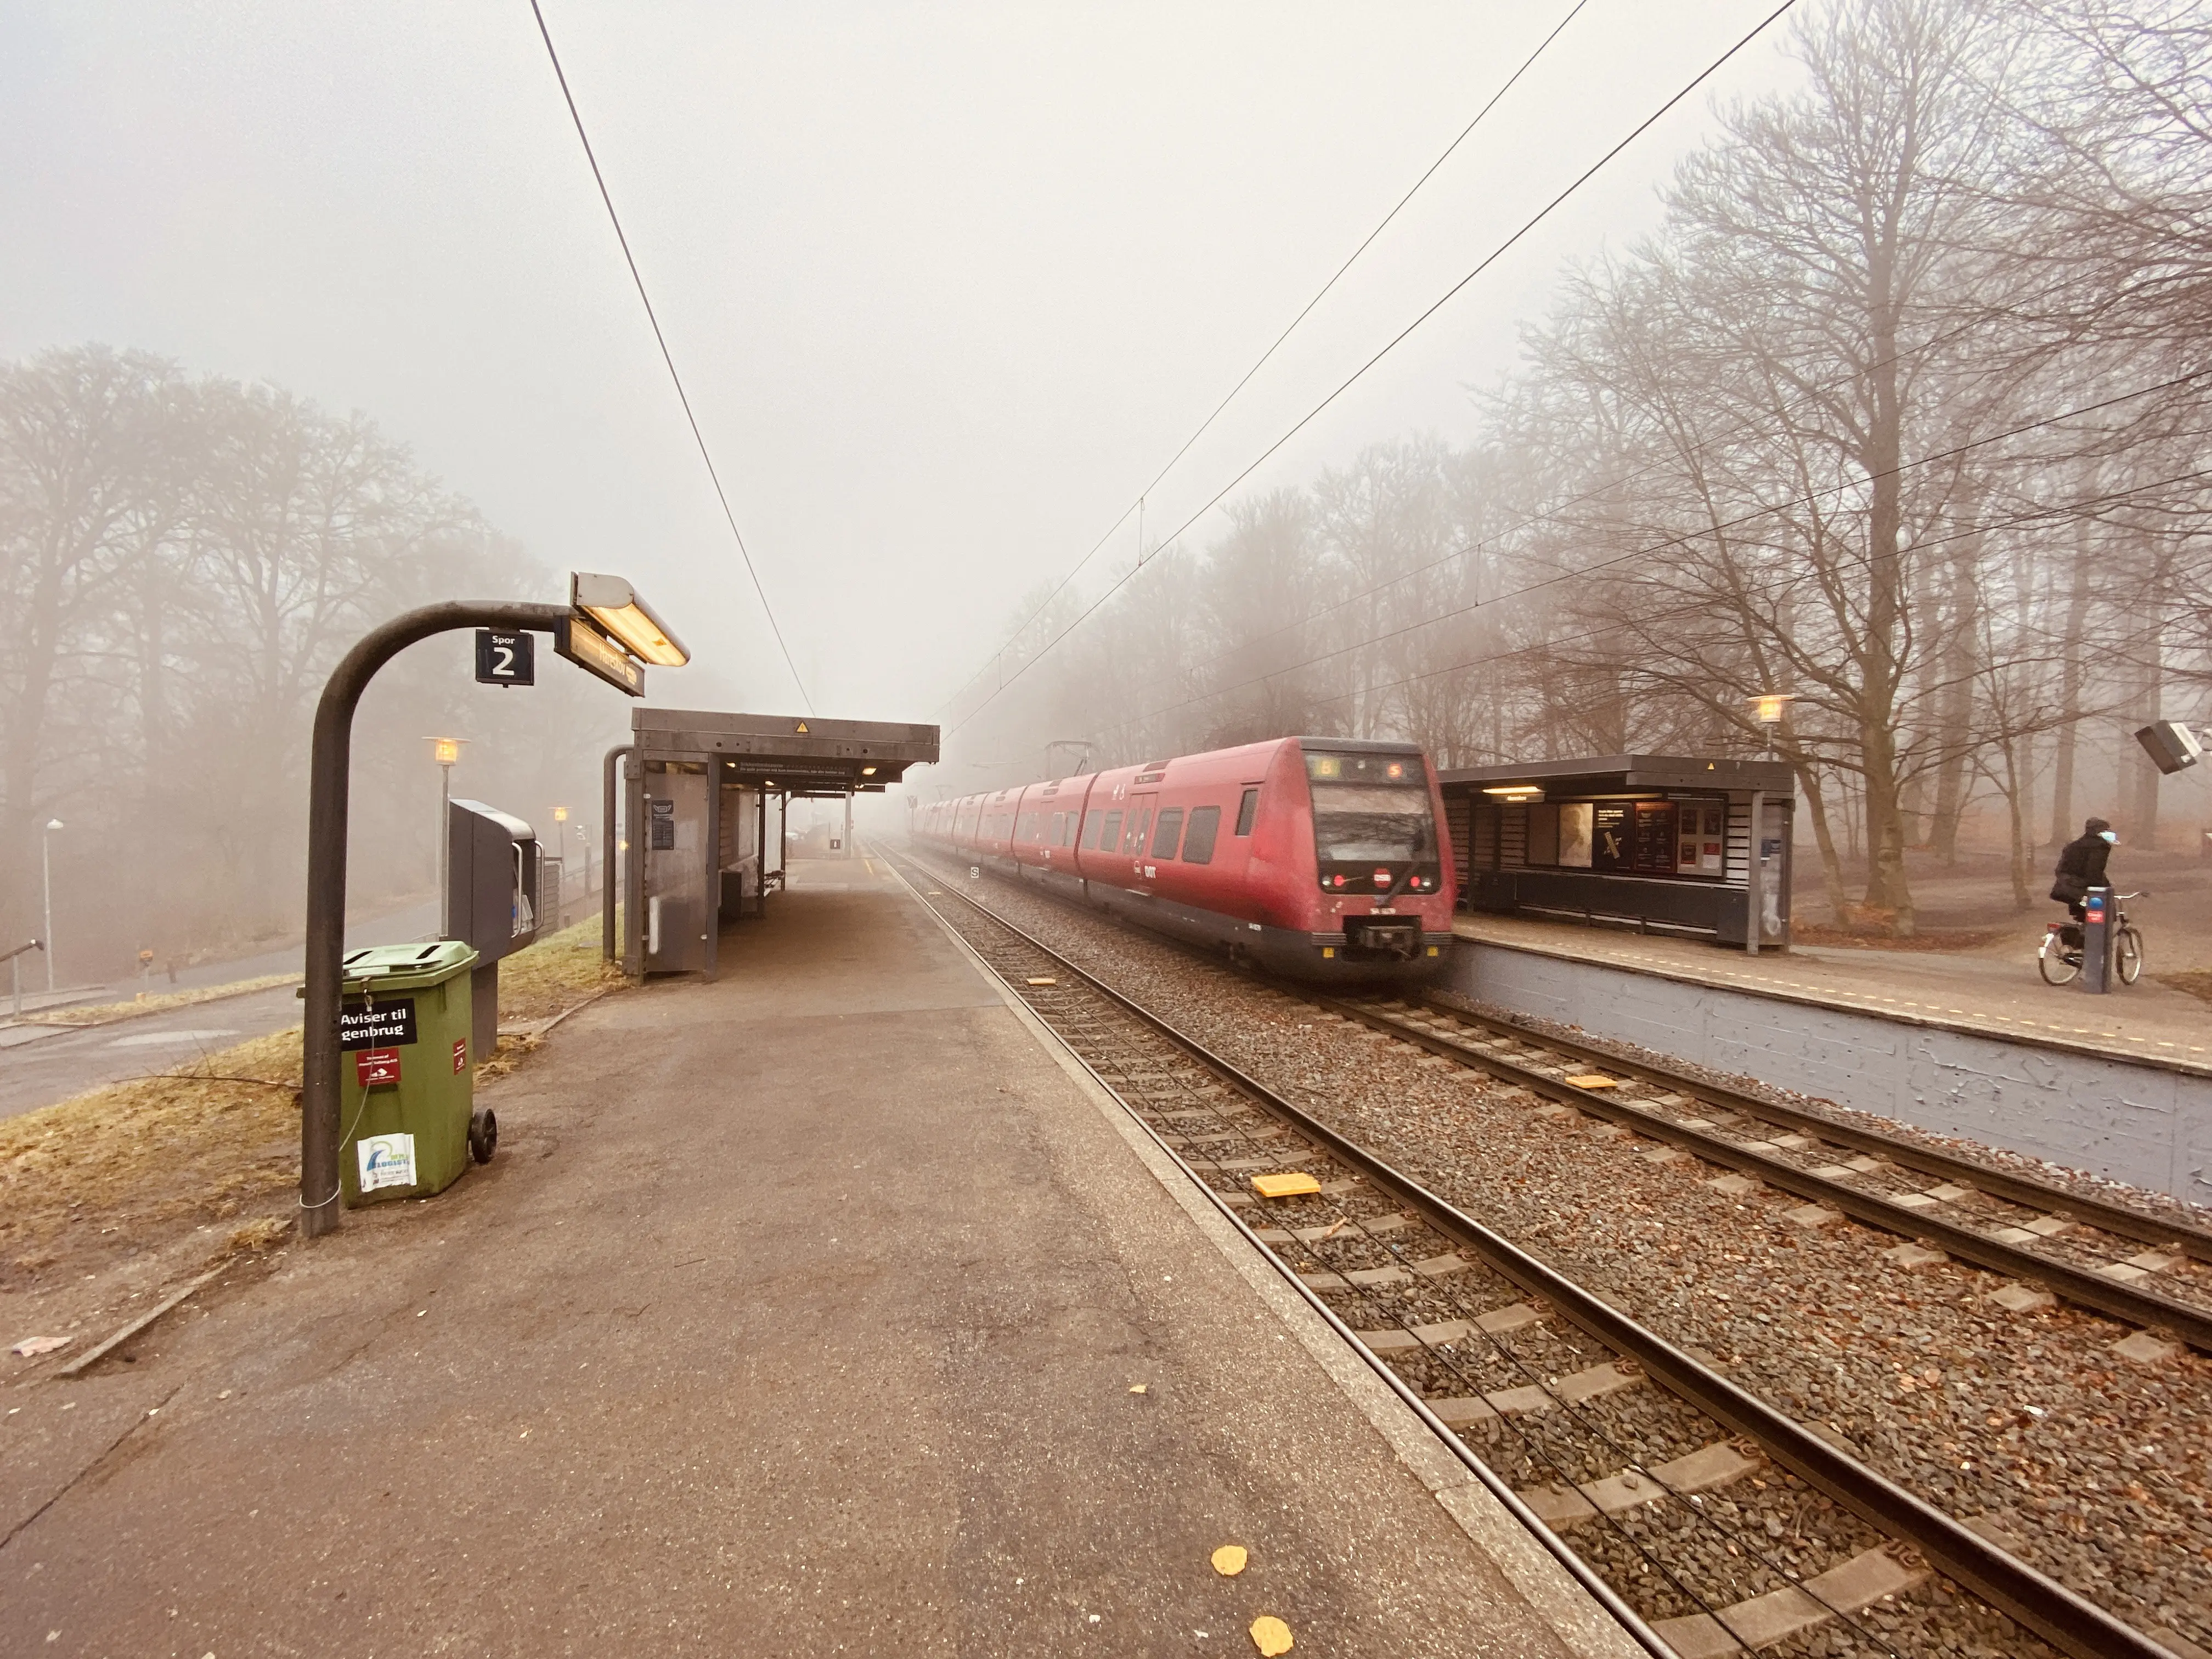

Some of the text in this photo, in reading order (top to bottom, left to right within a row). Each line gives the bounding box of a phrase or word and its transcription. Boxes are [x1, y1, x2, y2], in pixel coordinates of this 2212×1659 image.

[492, 635, 515, 645] Spor
[493, 647, 515, 675] 2
[972, 868, 978, 877] S
[341, 1008, 407, 1025] Aviser til
[342, 1025, 404, 1041] genbrug
